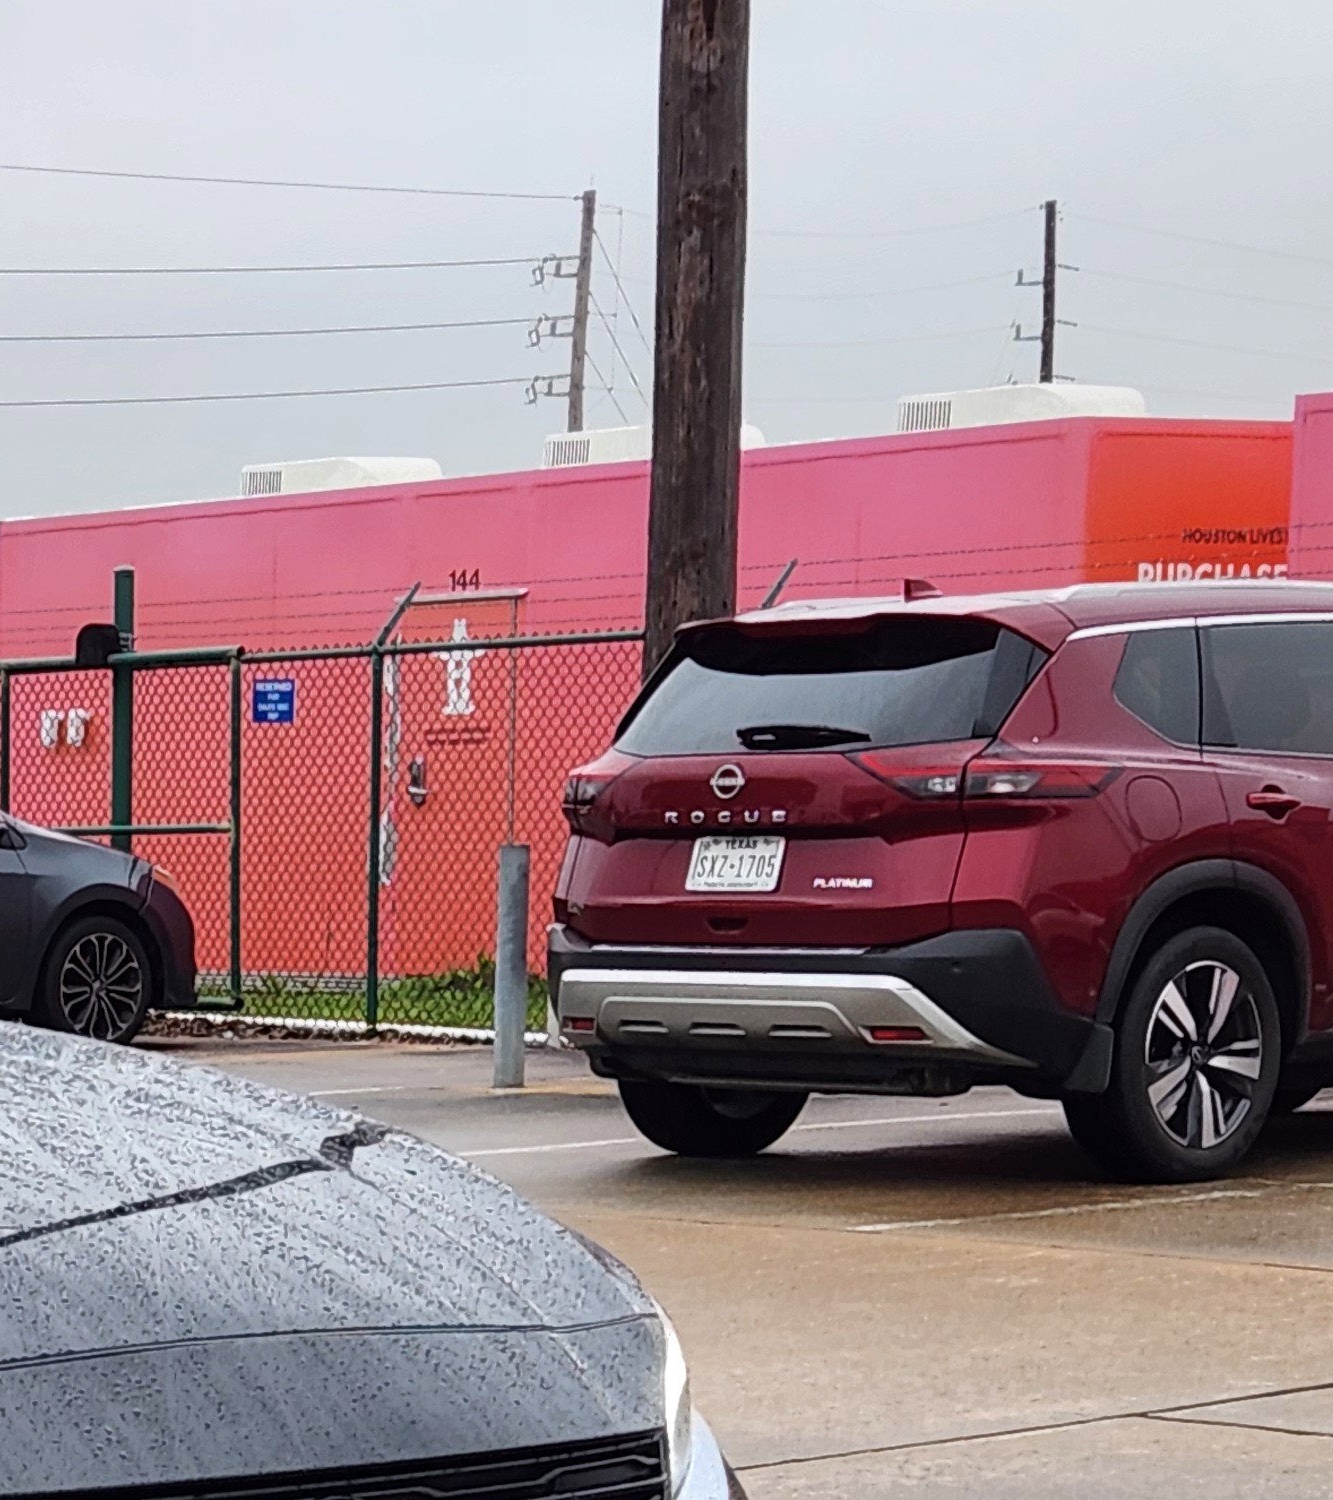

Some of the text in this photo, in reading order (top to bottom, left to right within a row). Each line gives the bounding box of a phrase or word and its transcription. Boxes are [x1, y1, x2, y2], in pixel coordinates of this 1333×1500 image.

[1183, 528, 1247, 545] HOUSTON
[449, 568, 482, 592] 144
[1138, 562, 1289, 582] PURCHASE
[665, 810, 786, 824] ROGUE
